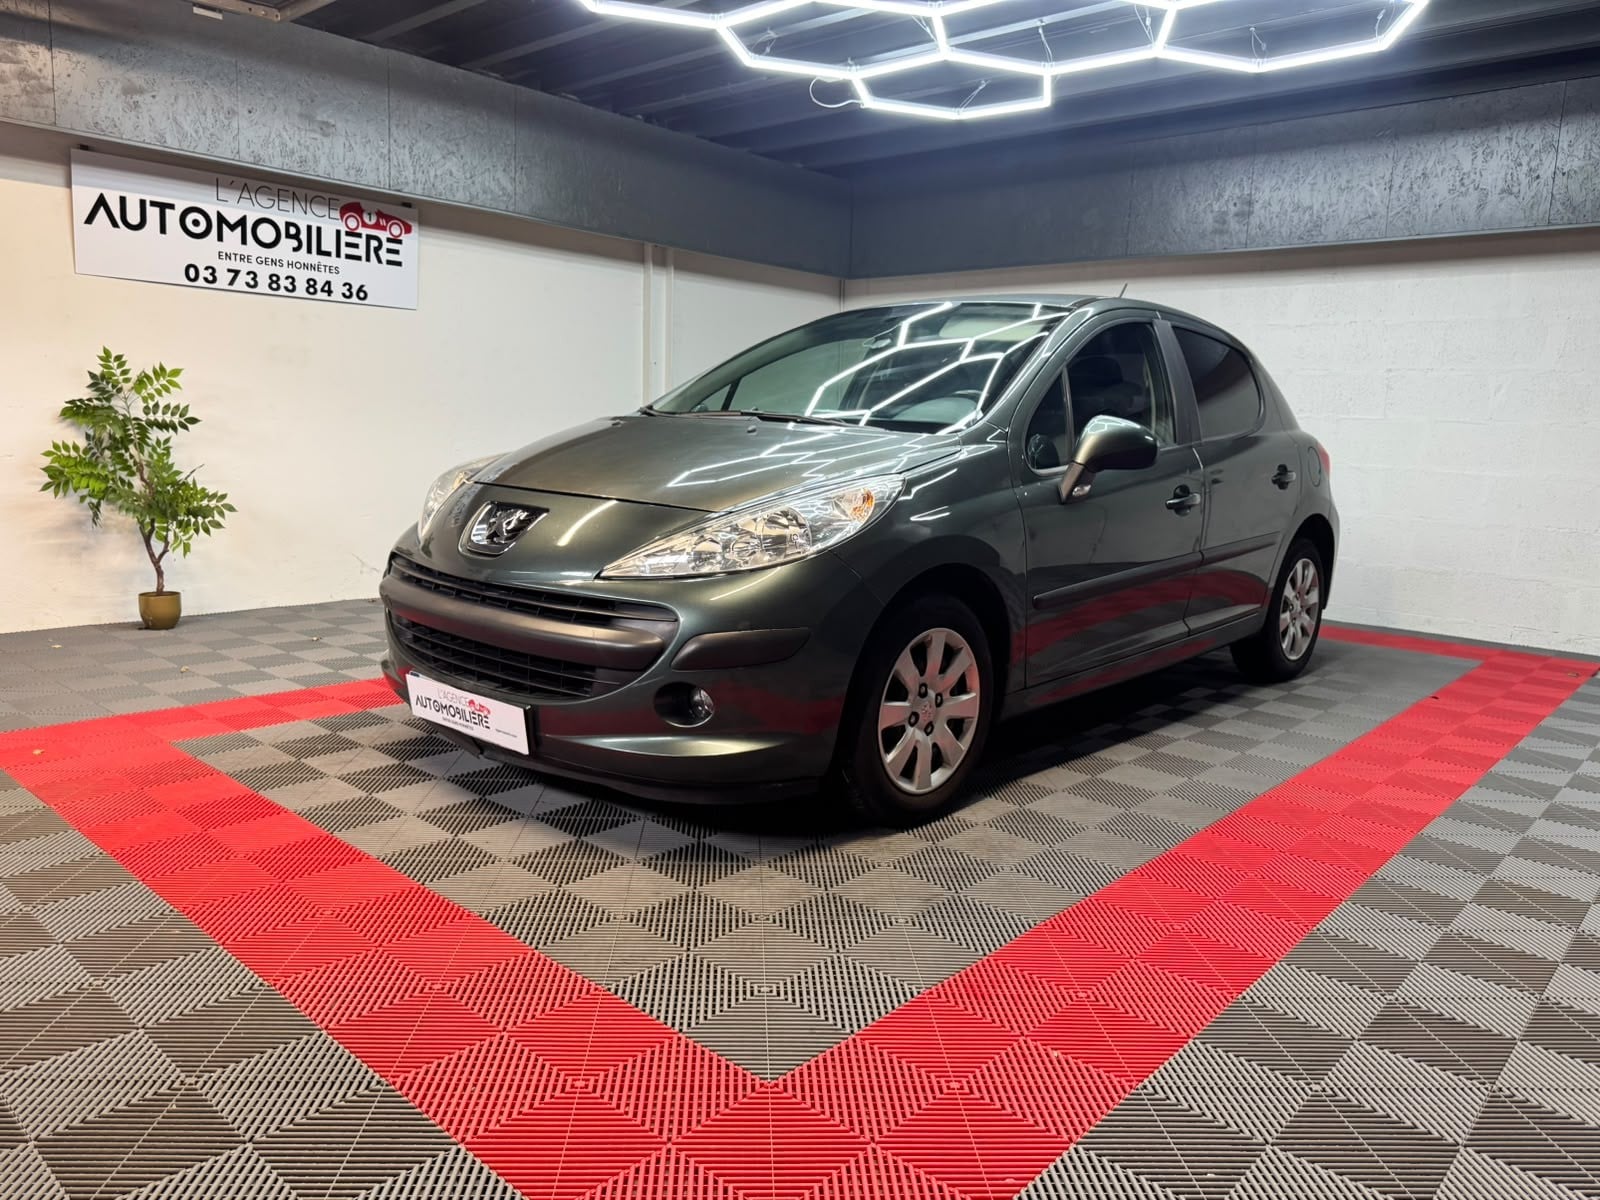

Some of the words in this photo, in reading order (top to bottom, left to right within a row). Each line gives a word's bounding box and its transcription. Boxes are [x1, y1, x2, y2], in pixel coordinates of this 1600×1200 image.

[215, 177, 340, 221] L'AGENCE
[366, 211, 373, 222] 1
[217, 251, 253, 264] ENTRE
[255, 257, 284, 268] GENS
[287, 261, 340, 275] HONNÊTES
[184, 263, 218, 284] 03
[226, 268, 259, 289] 73
[268, 273, 297, 293] 83
[305, 278, 334, 297] 84
[341, 282, 369, 301] 36
